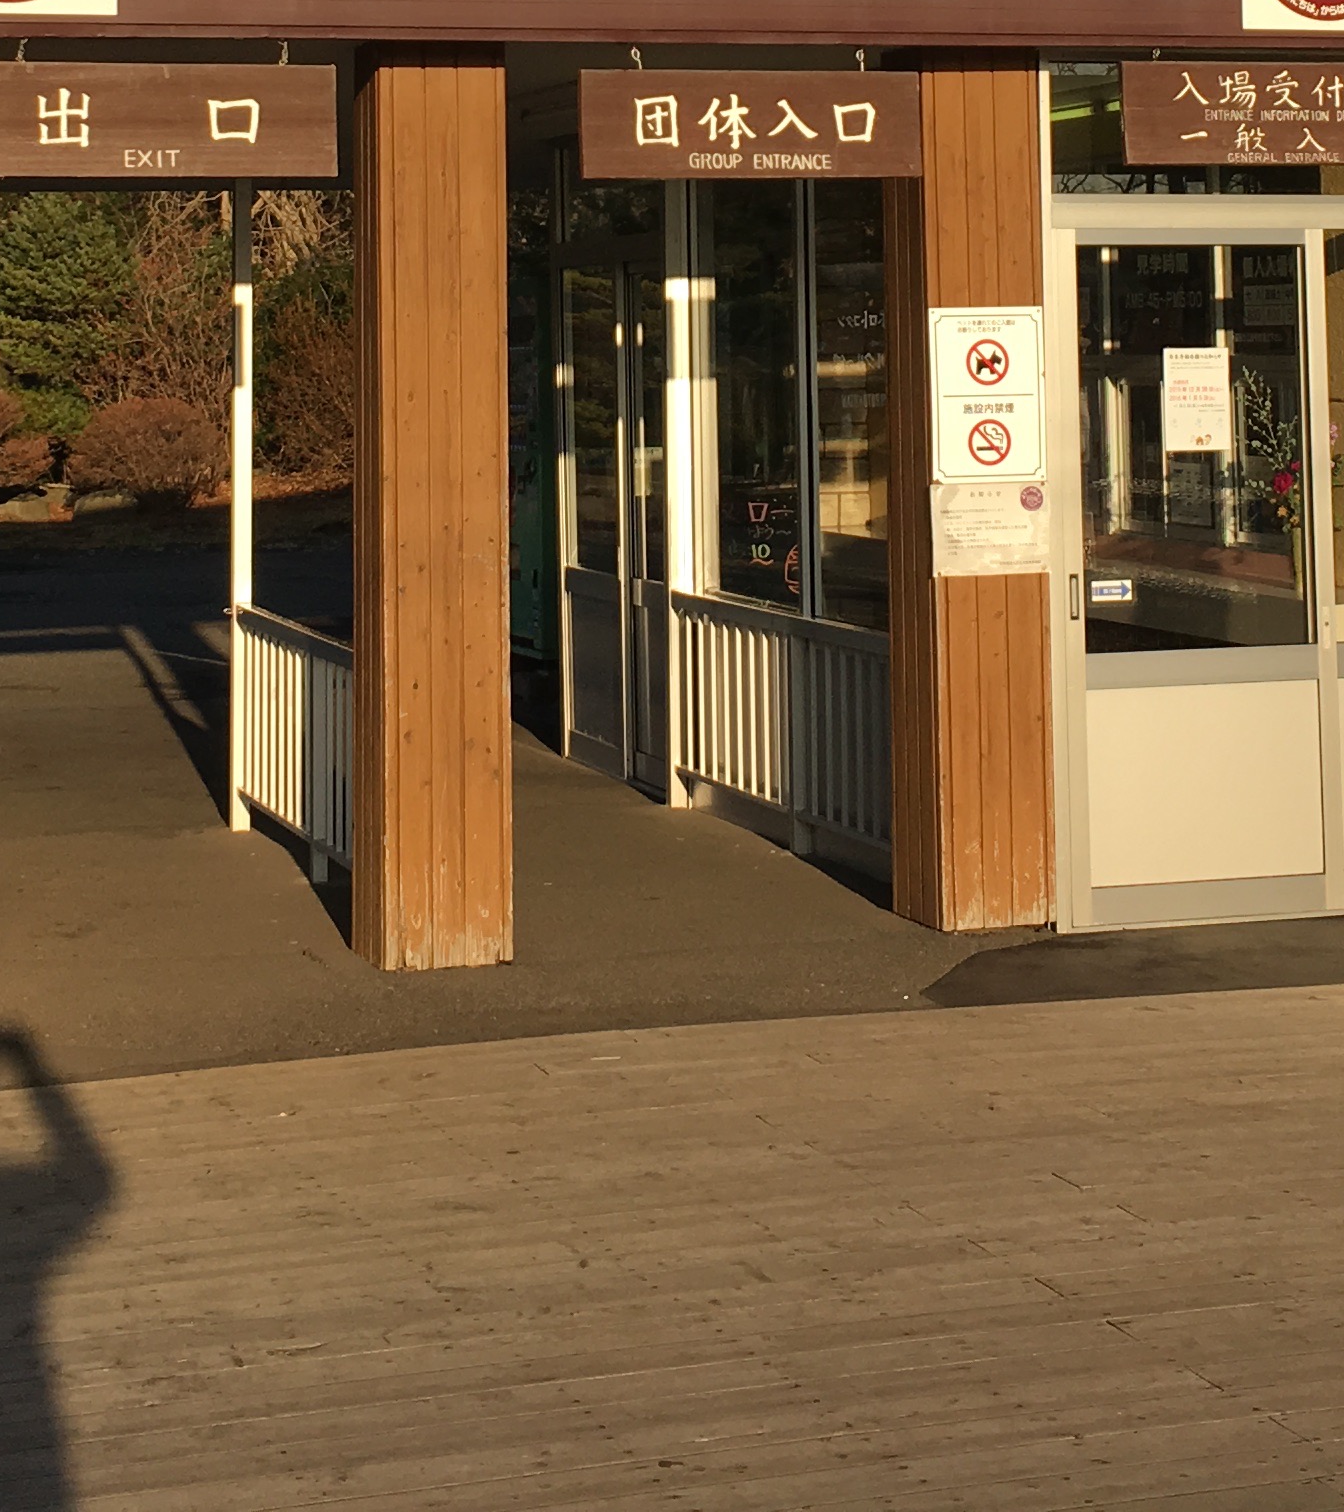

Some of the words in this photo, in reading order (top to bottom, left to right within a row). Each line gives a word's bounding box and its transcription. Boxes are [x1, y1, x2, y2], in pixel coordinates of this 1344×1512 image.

[633, 94, 877, 150] 団体入口
[1204, 109, 1255, 122] ENTRANCE
[1260, 109, 1331, 122] INFORMATION
[123, 149, 181, 169] EXIT
[688, 152, 744, 171] GROUP
[753, 153, 833, 171] ENTRANCE
[1227, 152, 1278, 163] GENERAL
[1284, 152, 1341, 163] ENTRANCE
[962, 402, 1015, 414] 施設内禁煙
